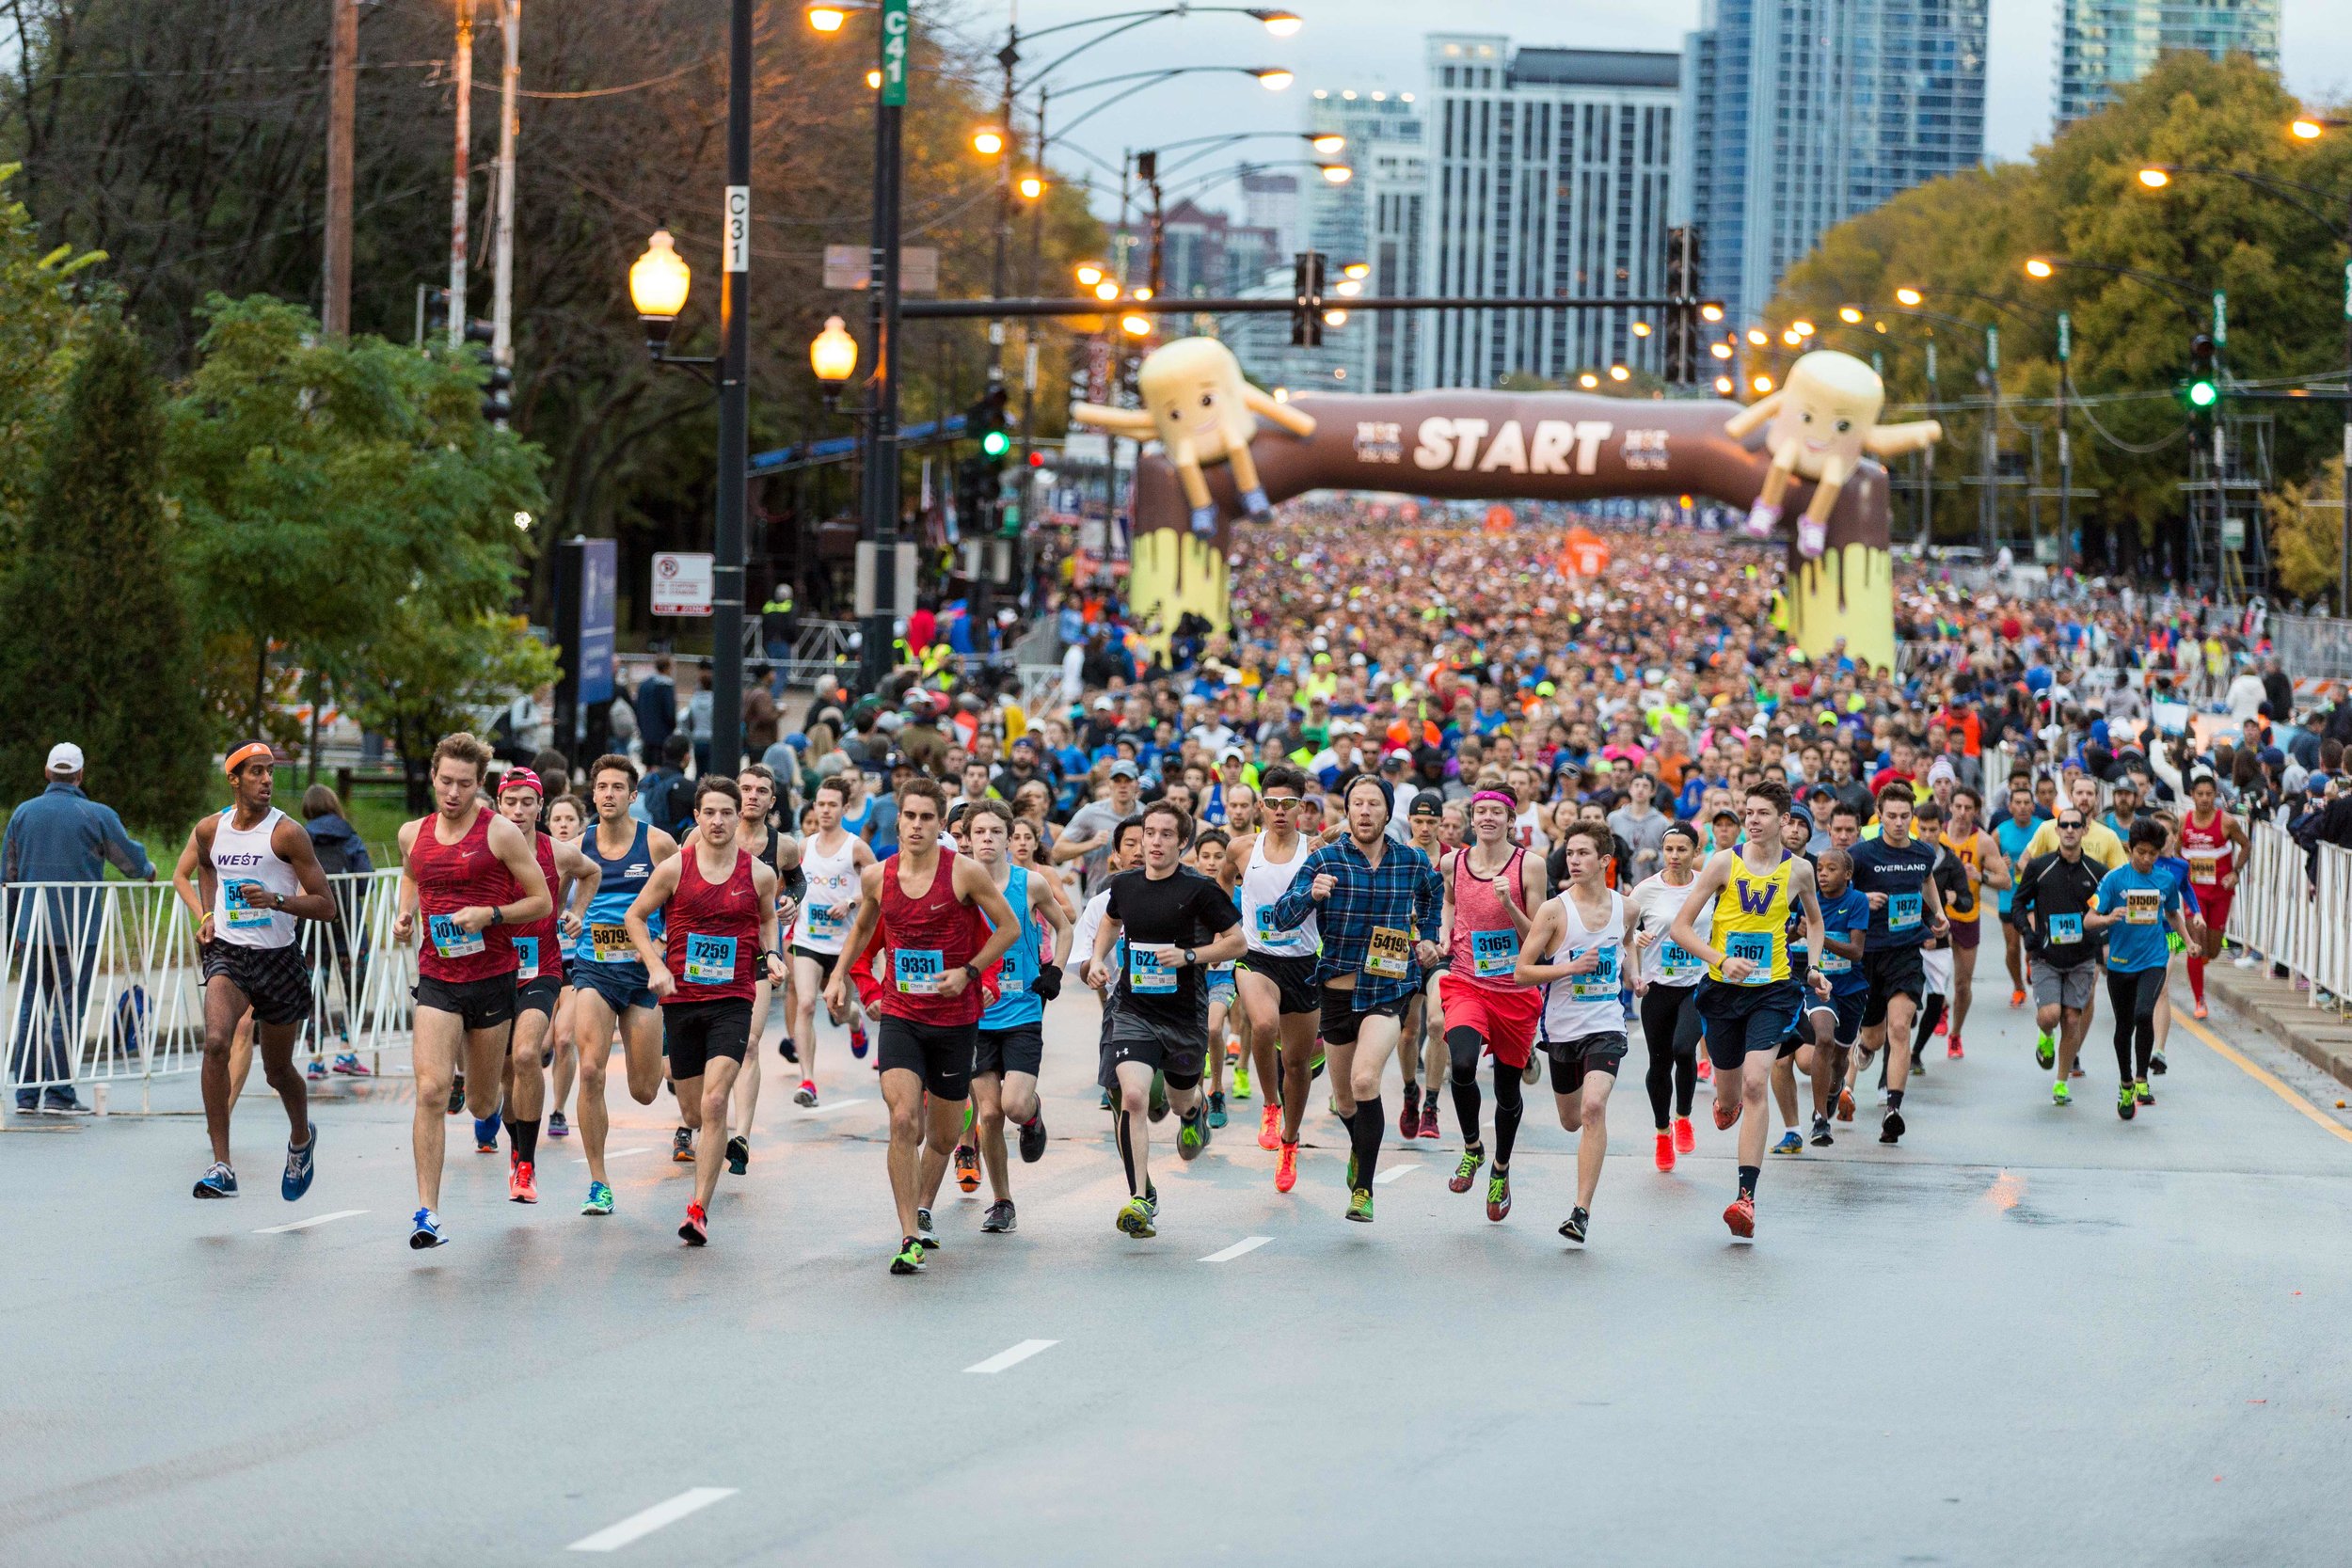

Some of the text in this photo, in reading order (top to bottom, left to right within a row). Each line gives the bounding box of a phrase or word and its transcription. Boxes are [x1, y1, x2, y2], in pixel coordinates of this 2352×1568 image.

[885, 10, 908, 83] C41
[730, 194, 745, 263] C31
[1413, 416, 1613, 475] START
[217, 852, 263, 865] WEST
[1874, 863, 1927, 873] OVERLAND
[805, 872, 848, 889] Google
[1735, 878, 1779, 917] W
[1895, 898, 1917, 911] 1872
[2129, 895, 2158, 905] 51506
[2058, 919, 2075, 929] 149
[694, 942, 729, 958] 7259
[1478, 935, 1512, 952] 3165
[440, 947, 449, 956] EL
[596, 952, 604, 960] EL
[1734, 944, 1765, 959] 3167
[901, 957, 935, 974] 9331
[1136, 951, 1163, 967] 622
[1371, 958, 1378, 967] A
[1480, 960, 1488, 969] A
[690, 966, 699, 974] EL
[1583, 960, 1612, 976] 00
[900, 983, 909, 991] EL
